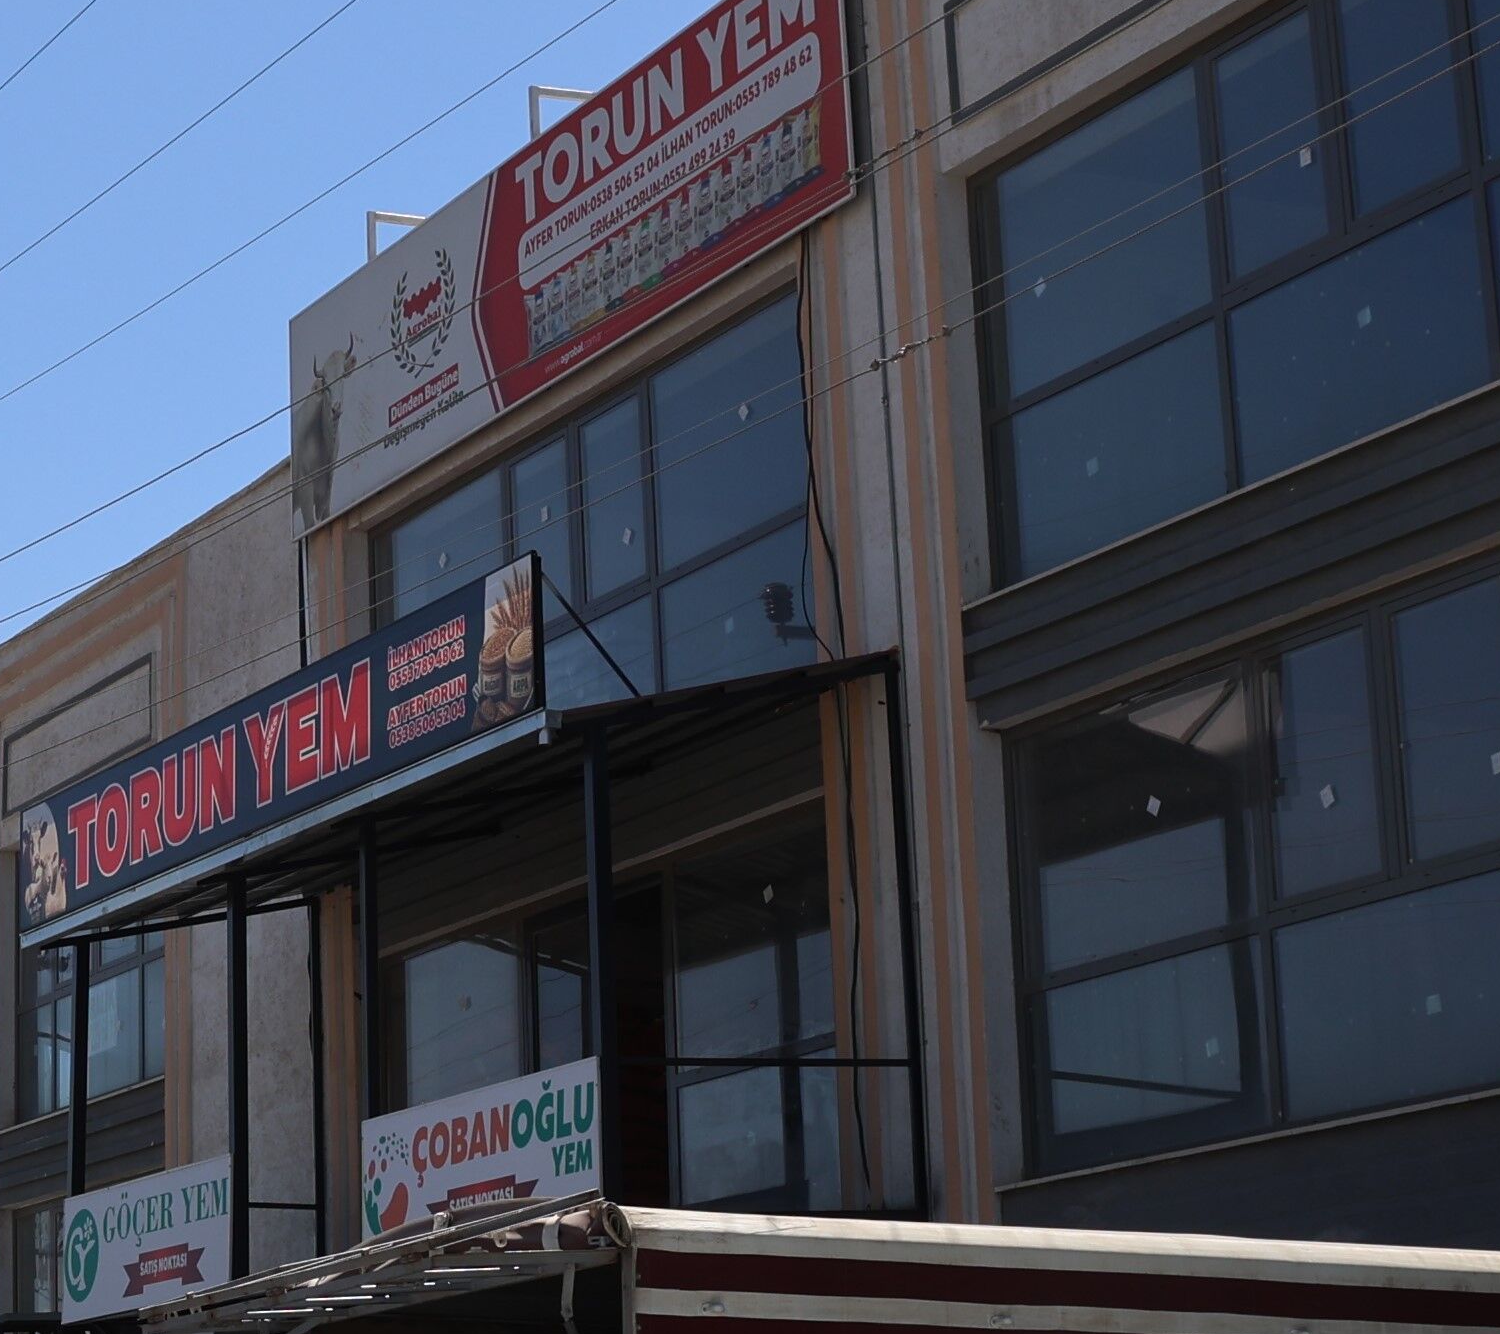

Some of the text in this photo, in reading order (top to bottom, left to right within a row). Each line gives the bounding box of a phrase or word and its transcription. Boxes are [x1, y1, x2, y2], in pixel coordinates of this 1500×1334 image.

[515, 48, 685, 225] TORUN
[525, 226, 553, 259] AYFER
[615, 172, 632, 196] 506
[634, 161, 646, 183] 52
[647, 154, 660, 173] 04
[661, 128, 694, 163] İLHAN
[763, 67, 781, 92] 789
[783, 56, 797, 77] 48
[799, 44, 813, 67] 62
[709, 141, 721, 159] 24
[723, 127, 736, 149] 39
[388, 615, 466, 672] İLHAN TORUN
[387, 674, 467, 730] AYFER TORUN
[67, 657, 372, 889] TORUN YEM
[412, 1079, 595, 1189] ÇOBANOĞLU
[551, 1138, 594, 1177] YEM
[103, 1177, 229, 1247] GÖÇER YEM
